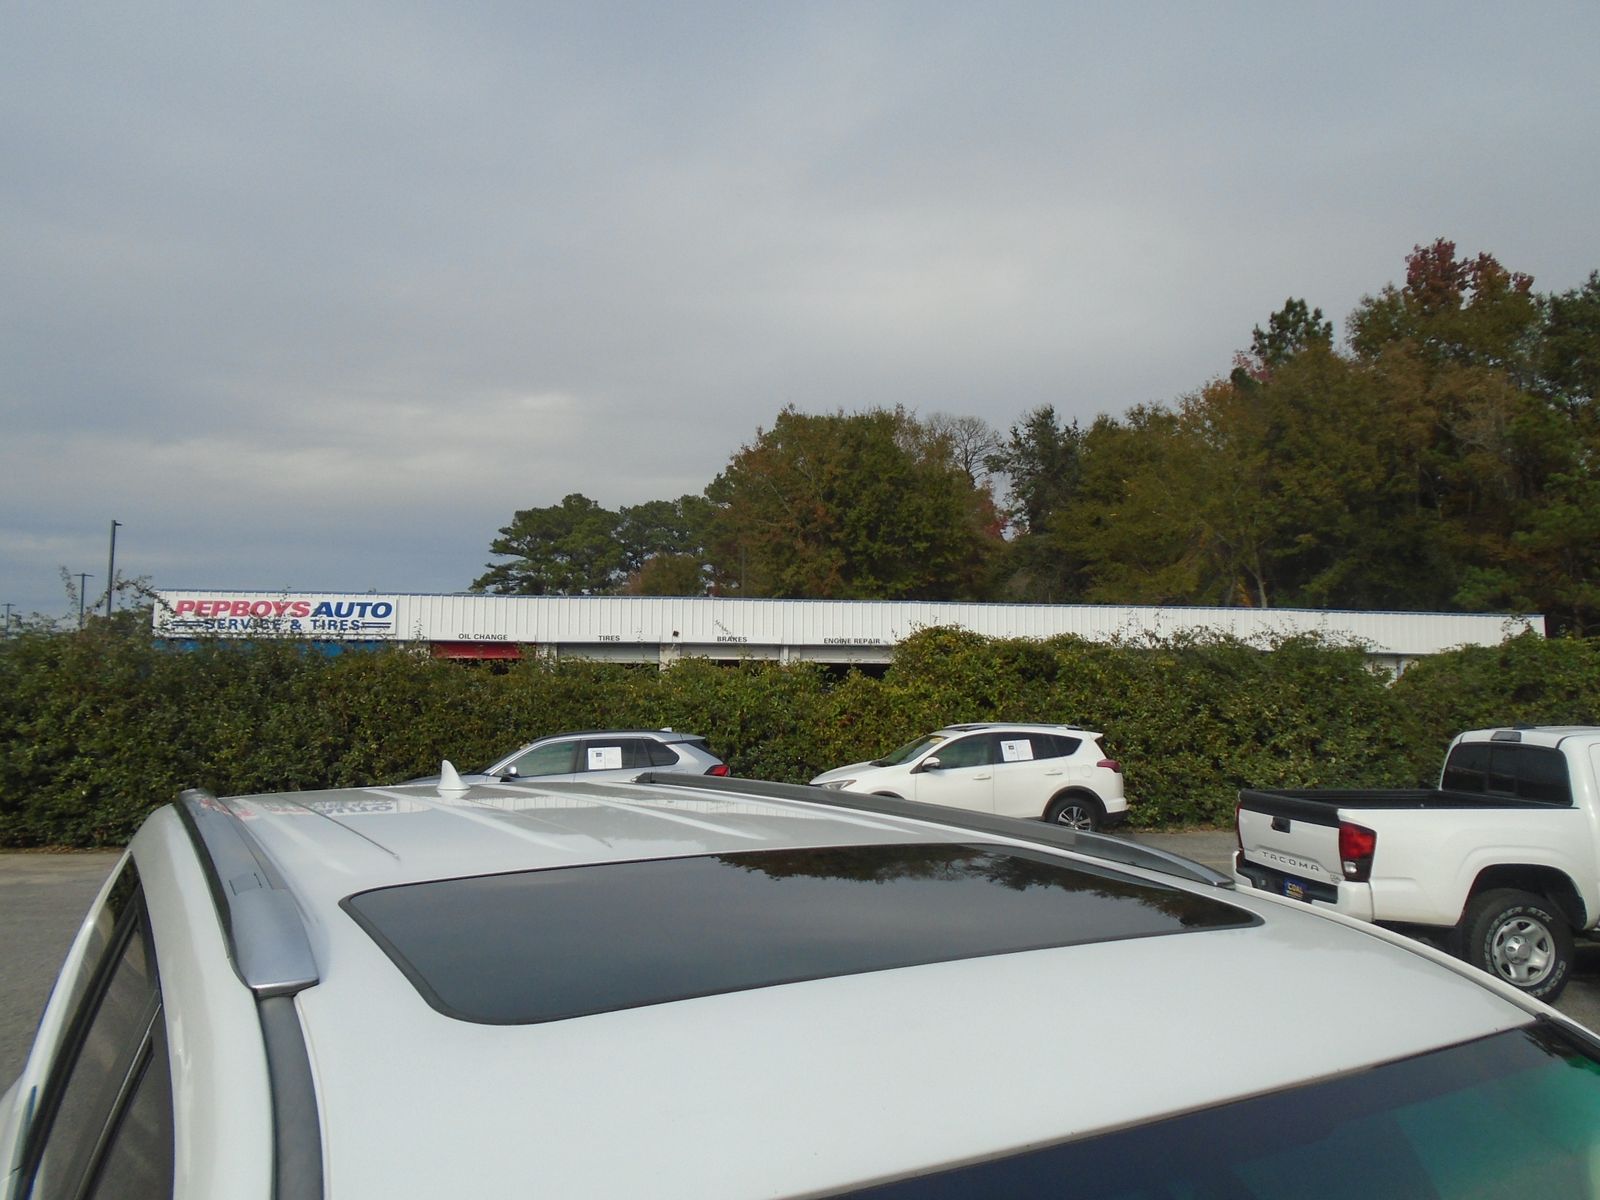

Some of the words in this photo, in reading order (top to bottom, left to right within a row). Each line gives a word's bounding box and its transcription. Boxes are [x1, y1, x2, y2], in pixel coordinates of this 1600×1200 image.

[312, 602, 392, 618] AUTO
[290, 618, 302, 630] &
[310, 619, 361, 631] TIRES
[473, 633, 508, 641] CHANGE
[823, 637, 851, 645] ENGINE
[1262, 851, 1320, 873] TACOMA
